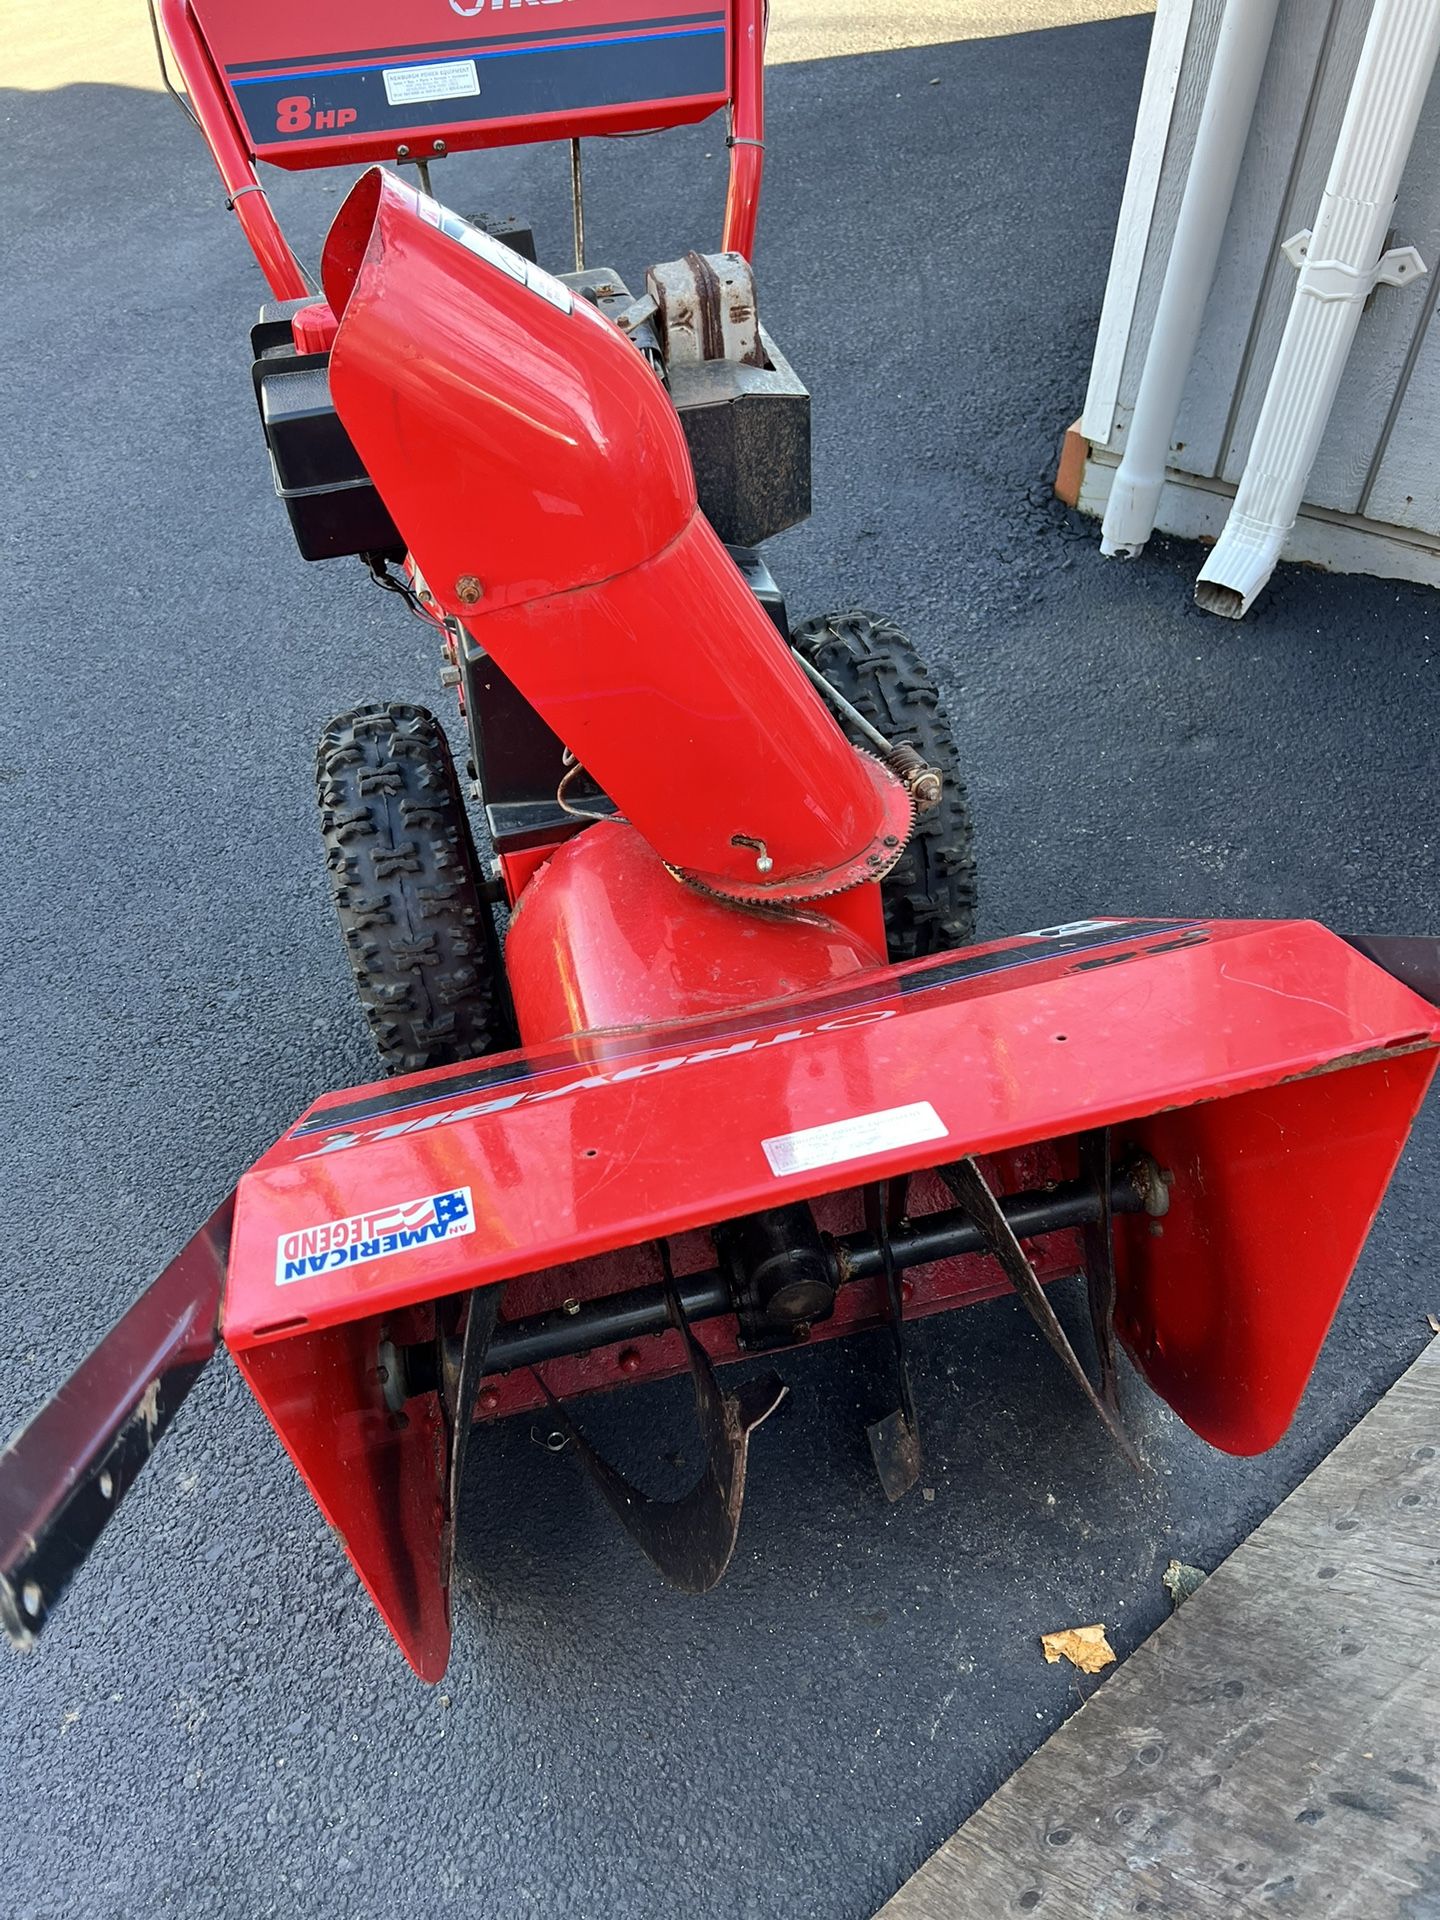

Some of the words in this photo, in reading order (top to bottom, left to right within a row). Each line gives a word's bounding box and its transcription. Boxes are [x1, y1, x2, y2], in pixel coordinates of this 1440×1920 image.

[440, 66, 470, 76] EQUIPMENT
[276, 95, 312, 133] 8
[315, 107, 358, 131] HP
[284, 1214, 378, 1261] LEGEND
[449, 1223, 469, 1236] AN
[284, 1222, 450, 1280] AMERICAN
